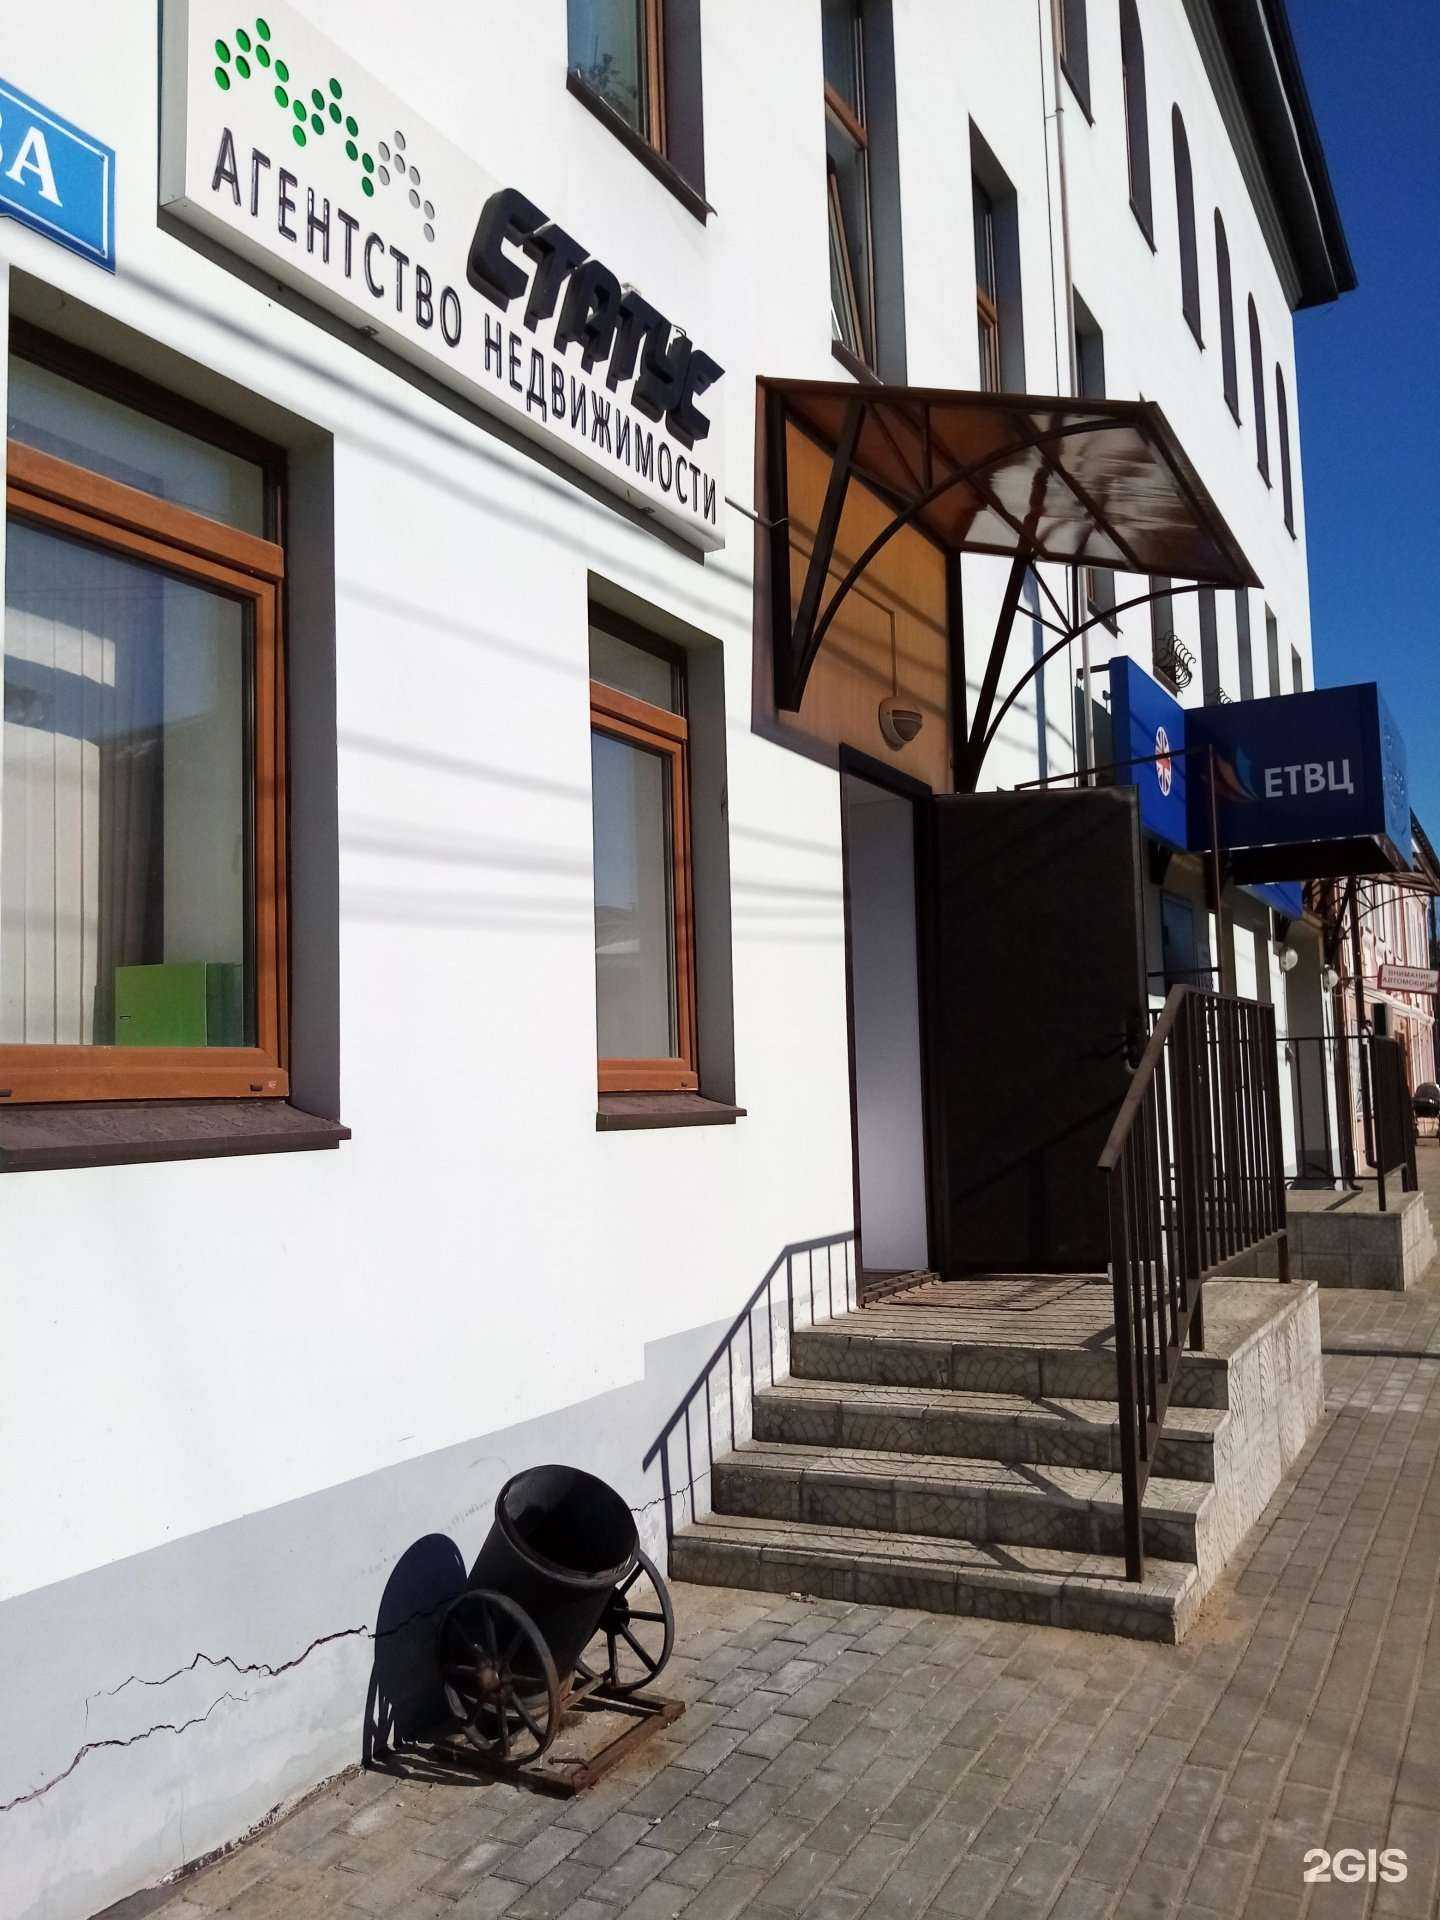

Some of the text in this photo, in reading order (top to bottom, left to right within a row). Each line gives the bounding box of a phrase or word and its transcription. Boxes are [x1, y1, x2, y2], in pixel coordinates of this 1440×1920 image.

[0, 111, 63, 208] А
[211, 127, 717, 525] АГЕНТСТВО НЕДВИЖИМОСТИ
[466, 187, 726, 451] СТАТУС
[1264, 758, 1354, 798] ЕТВЦ
[1382, 976, 1436, 988] АВТОМОБИ
